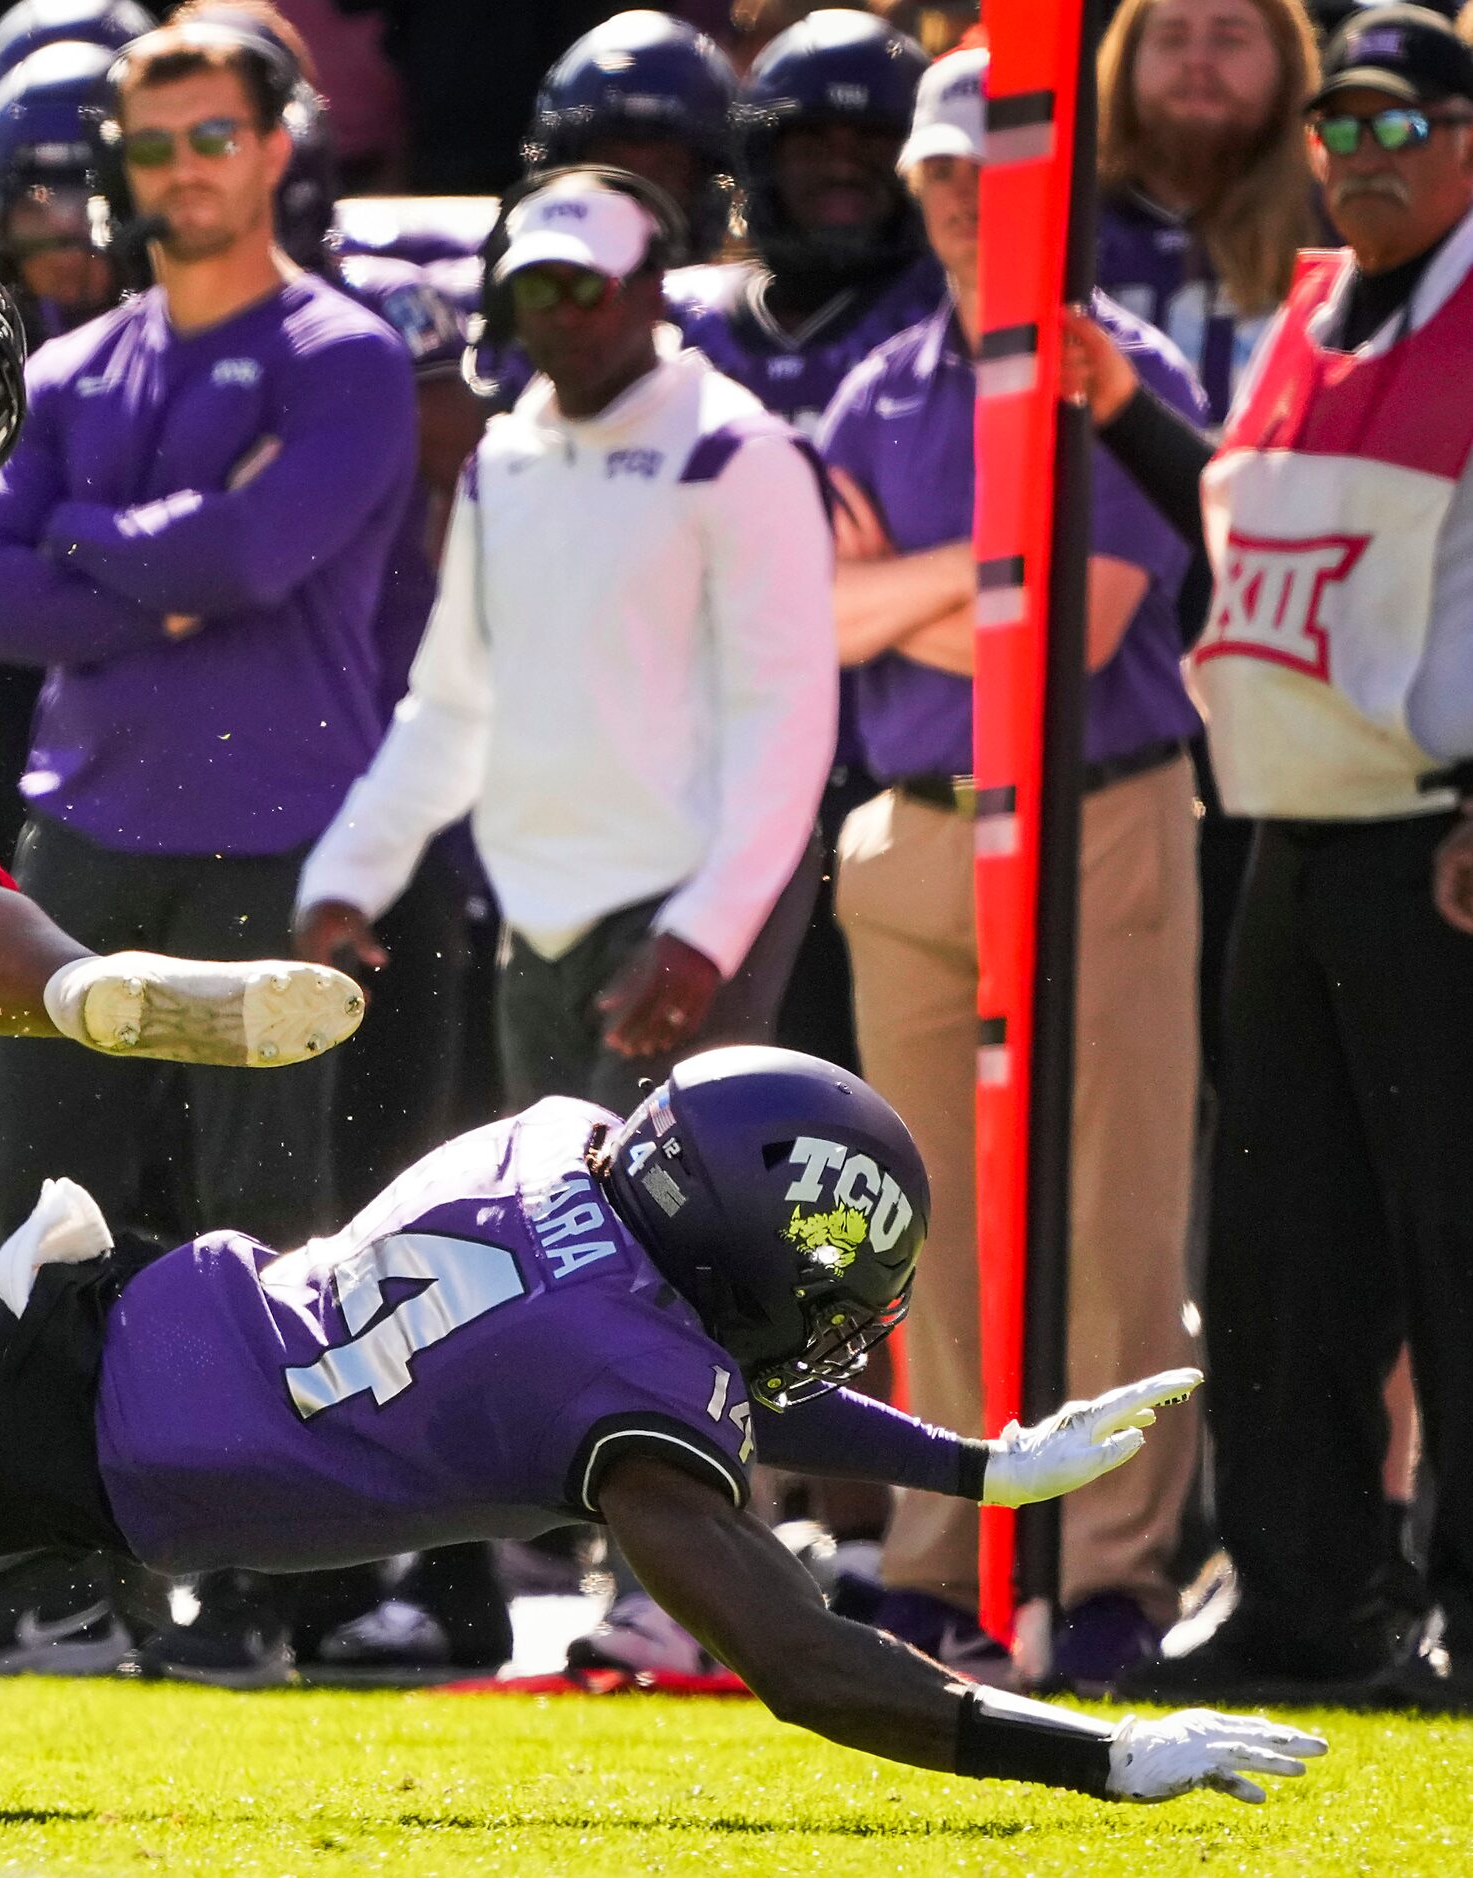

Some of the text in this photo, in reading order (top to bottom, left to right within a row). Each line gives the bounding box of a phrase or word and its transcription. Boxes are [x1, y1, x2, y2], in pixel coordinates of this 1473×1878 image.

[662, 1137, 682, 1159] 12
[785, 1136, 913, 1253] TCU
[706, 1365, 754, 1464] 14
